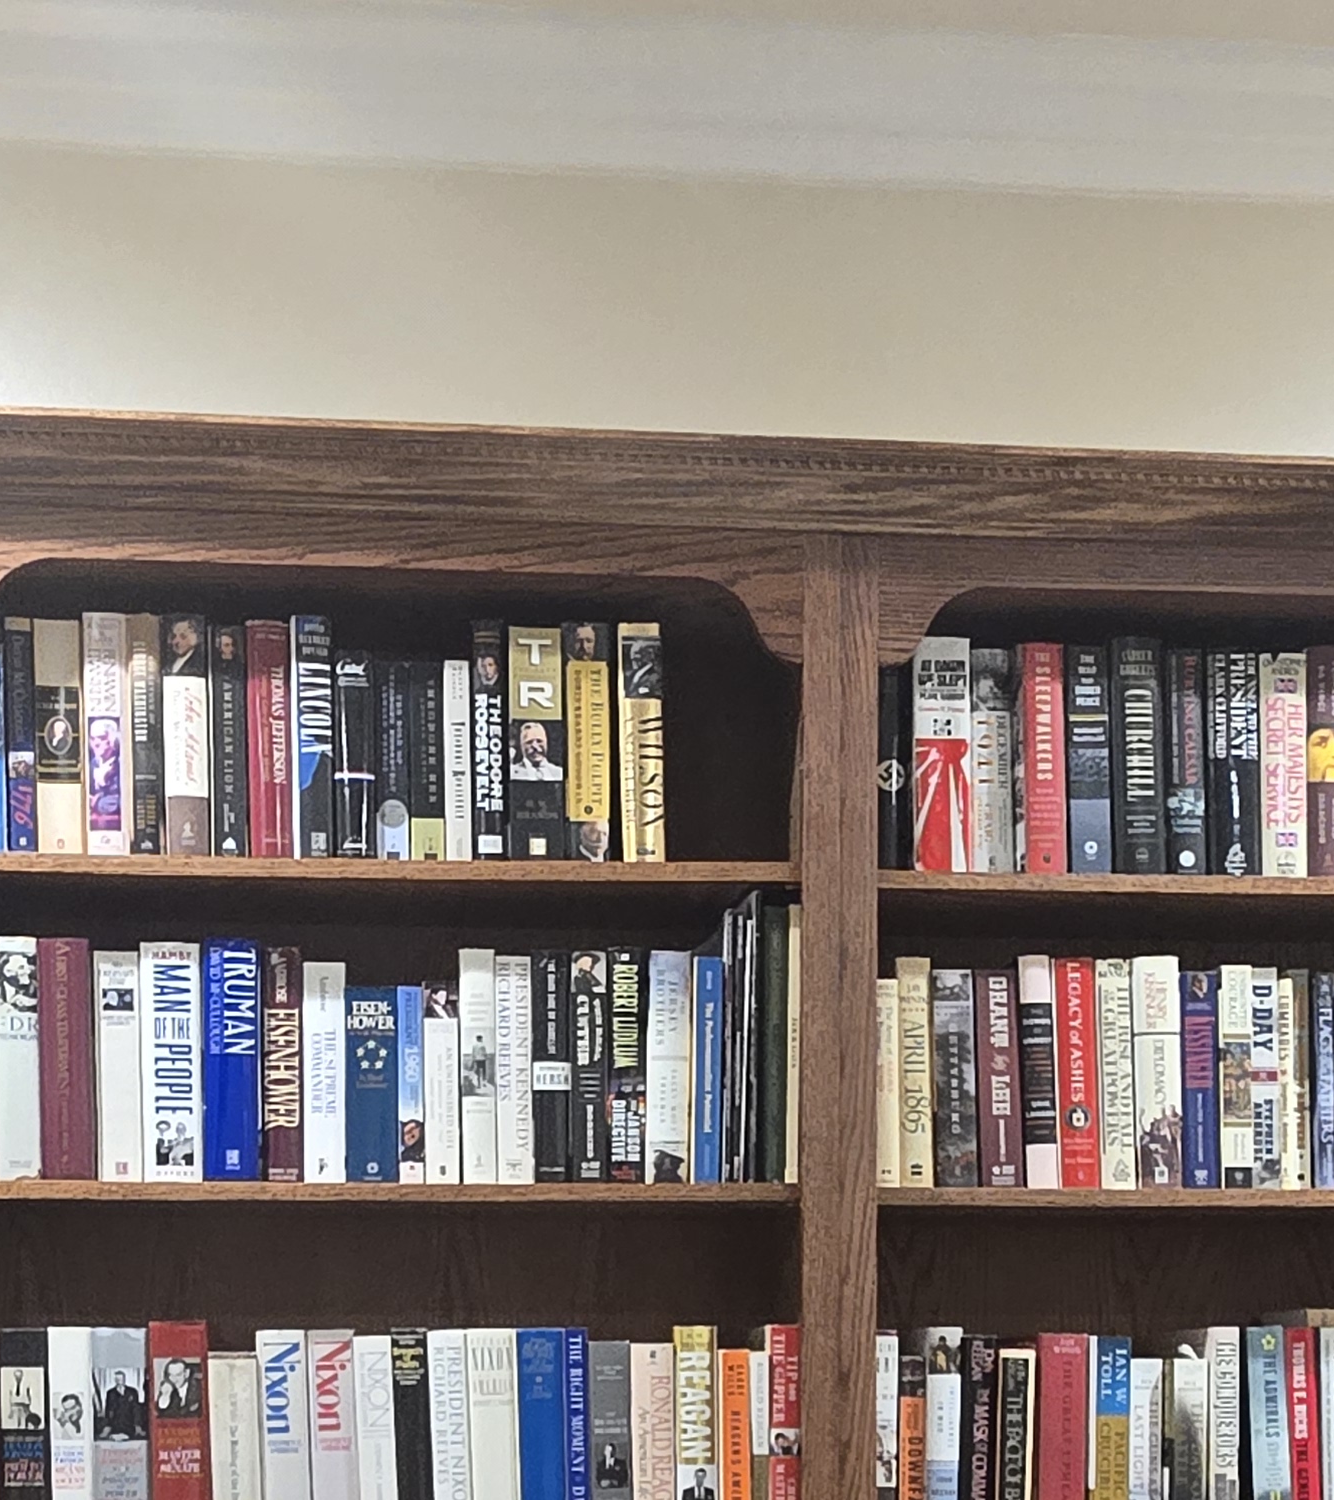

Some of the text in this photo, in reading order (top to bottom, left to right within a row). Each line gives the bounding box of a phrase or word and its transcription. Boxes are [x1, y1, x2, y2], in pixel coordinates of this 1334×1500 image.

[517, 637, 552, 665] T
[298, 663, 333, 758] LINCOLN
[520, 681, 555, 710] R
[1035, 666, 1054, 781] SLEEPWALKERS
[1266, 697, 1284, 758] SECRET
[1287, 704, 1303, 737] HER
[475, 693, 489, 811] ROOSEVELT
[490, 694, 503, 811] THEODORE
[638, 717, 663, 828] WILSON
[1125, 689, 1155, 802] CHURCHILL
[153, 964, 191, 1012] MAN
[223, 948, 256, 1055] TRUMAN
[496, 962, 511, 1038] RICHARD
[612, 964, 638, 1012] ROBERT
[1067, 962, 1083, 1028] LEGACY
[1252, 985, 1274, 1052] D-DAY
[154, 1043, 193, 1115] PEOPLE
[264, 1008, 300, 1130] EISENHOWER
[514, 962, 529, 1152] PRESIDENT KENNEDY
[901, 1020, 930, 1134] APRIL 1865
[1070, 1048, 1085, 1102] ASHES
[991, 1075, 1011, 1116] LEE
[263, 1342, 302, 1435] Nixon
[314, 1341, 352, 1432] Nixon
[433, 1346, 447, 1421] RICHARD
[447, 1346, 465, 1448] PRESIDENT
[679, 1351, 711, 1458] REAGAN
[1101, 1353, 1112, 1400] TOLL
[1115, 1348, 1128, 1387] IAN
[651, 1375, 671, 1450] RONALD
